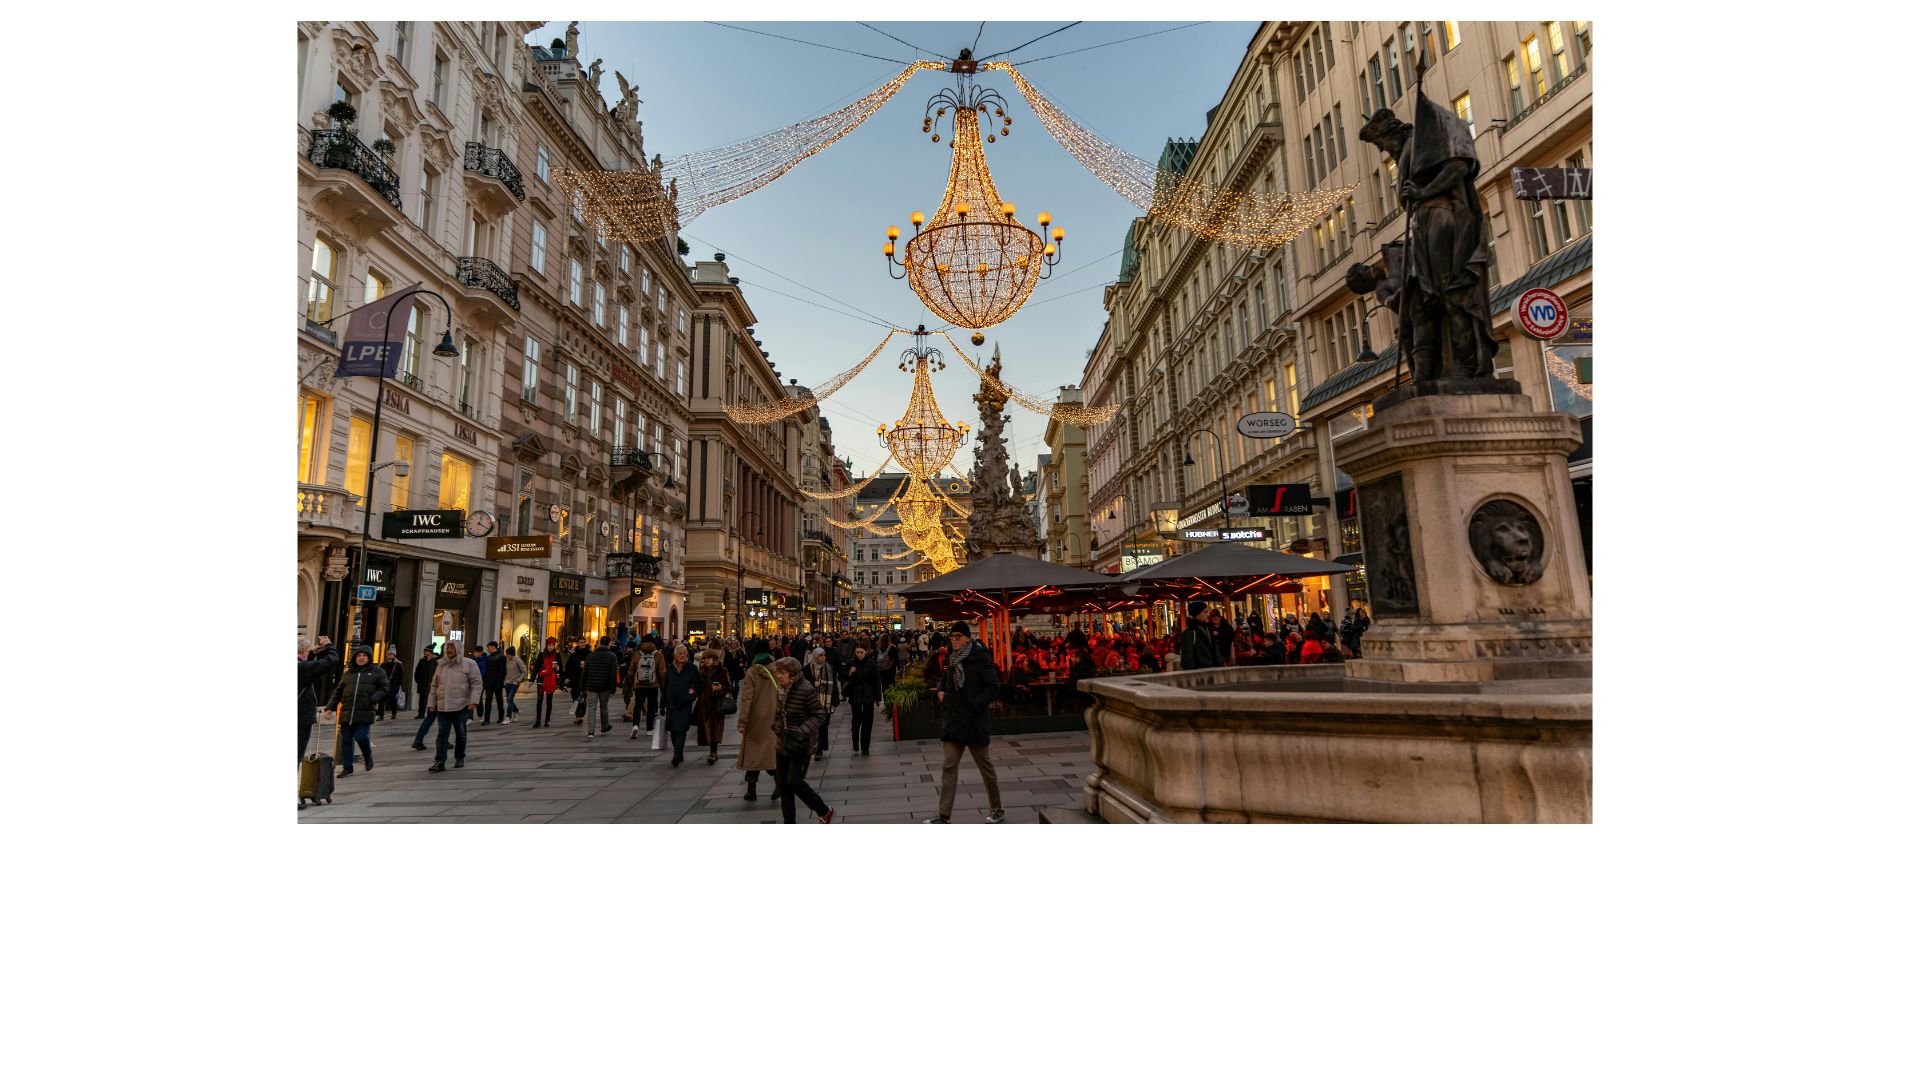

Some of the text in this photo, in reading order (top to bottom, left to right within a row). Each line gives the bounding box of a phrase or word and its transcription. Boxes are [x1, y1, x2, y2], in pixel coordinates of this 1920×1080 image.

[1530, 305, 1556, 321] VVD
[1246, 418, 1287, 428] WORSEG
[454, 422, 477, 446] LISKA
[1257, 506, 1268, 514] AM
[413, 514, 441, 527] IWC
[506, 543, 520, 552] 3SI
[366, 568, 383, 583] IWC
